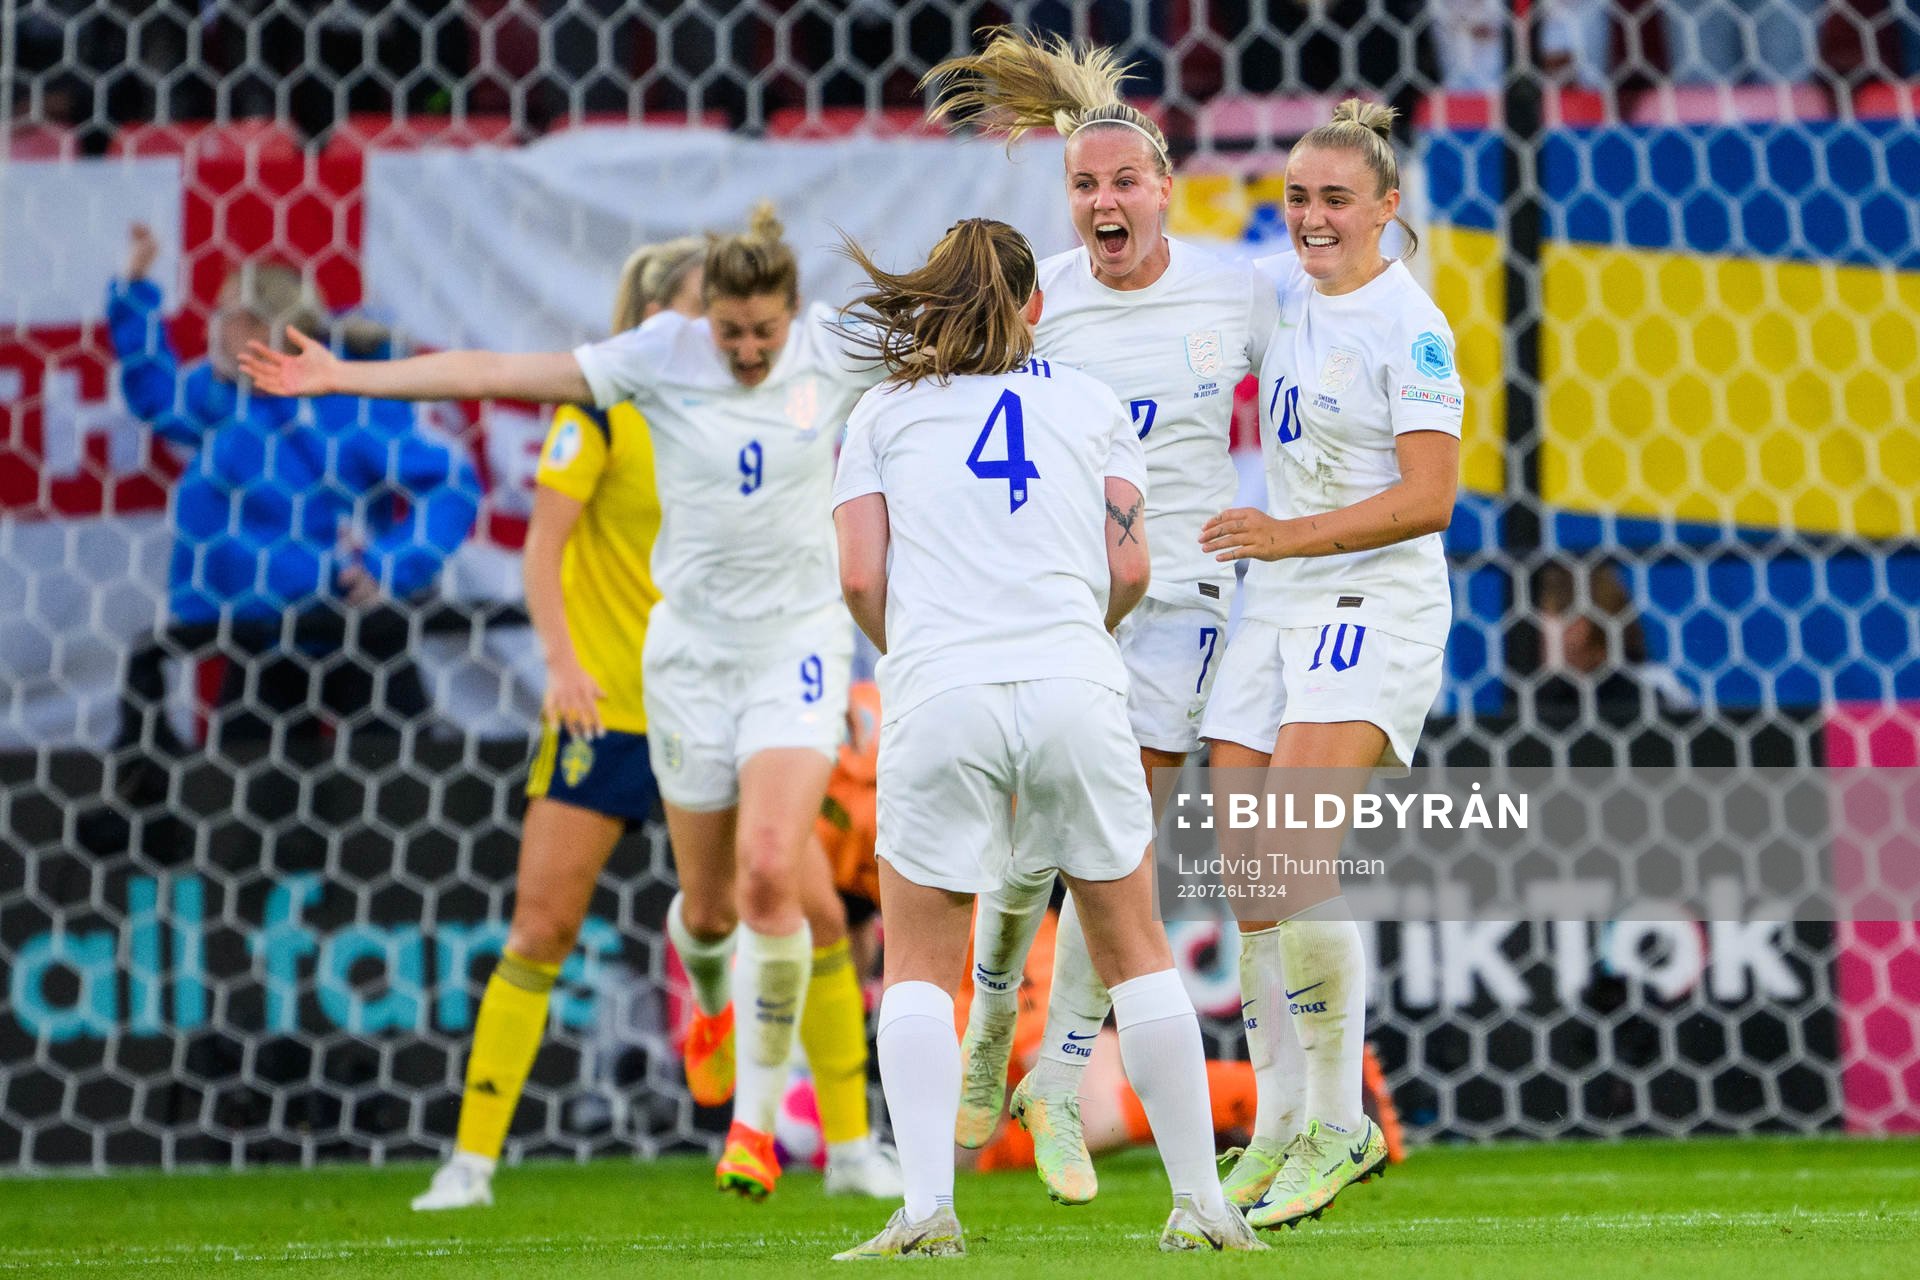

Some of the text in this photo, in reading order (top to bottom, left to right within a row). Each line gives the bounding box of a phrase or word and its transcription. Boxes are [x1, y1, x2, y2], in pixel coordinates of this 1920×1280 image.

[1269, 376, 1301, 445] 10
[1401, 389, 1461, 406] FOUNDATION
[738, 439, 764, 496] 9
[965, 388, 1040, 514] 4
[800, 654, 823, 704] 9
[1196, 627, 1218, 694] 7
[1308, 623, 1367, 673] 10
[10, 874, 206, 1040] all
